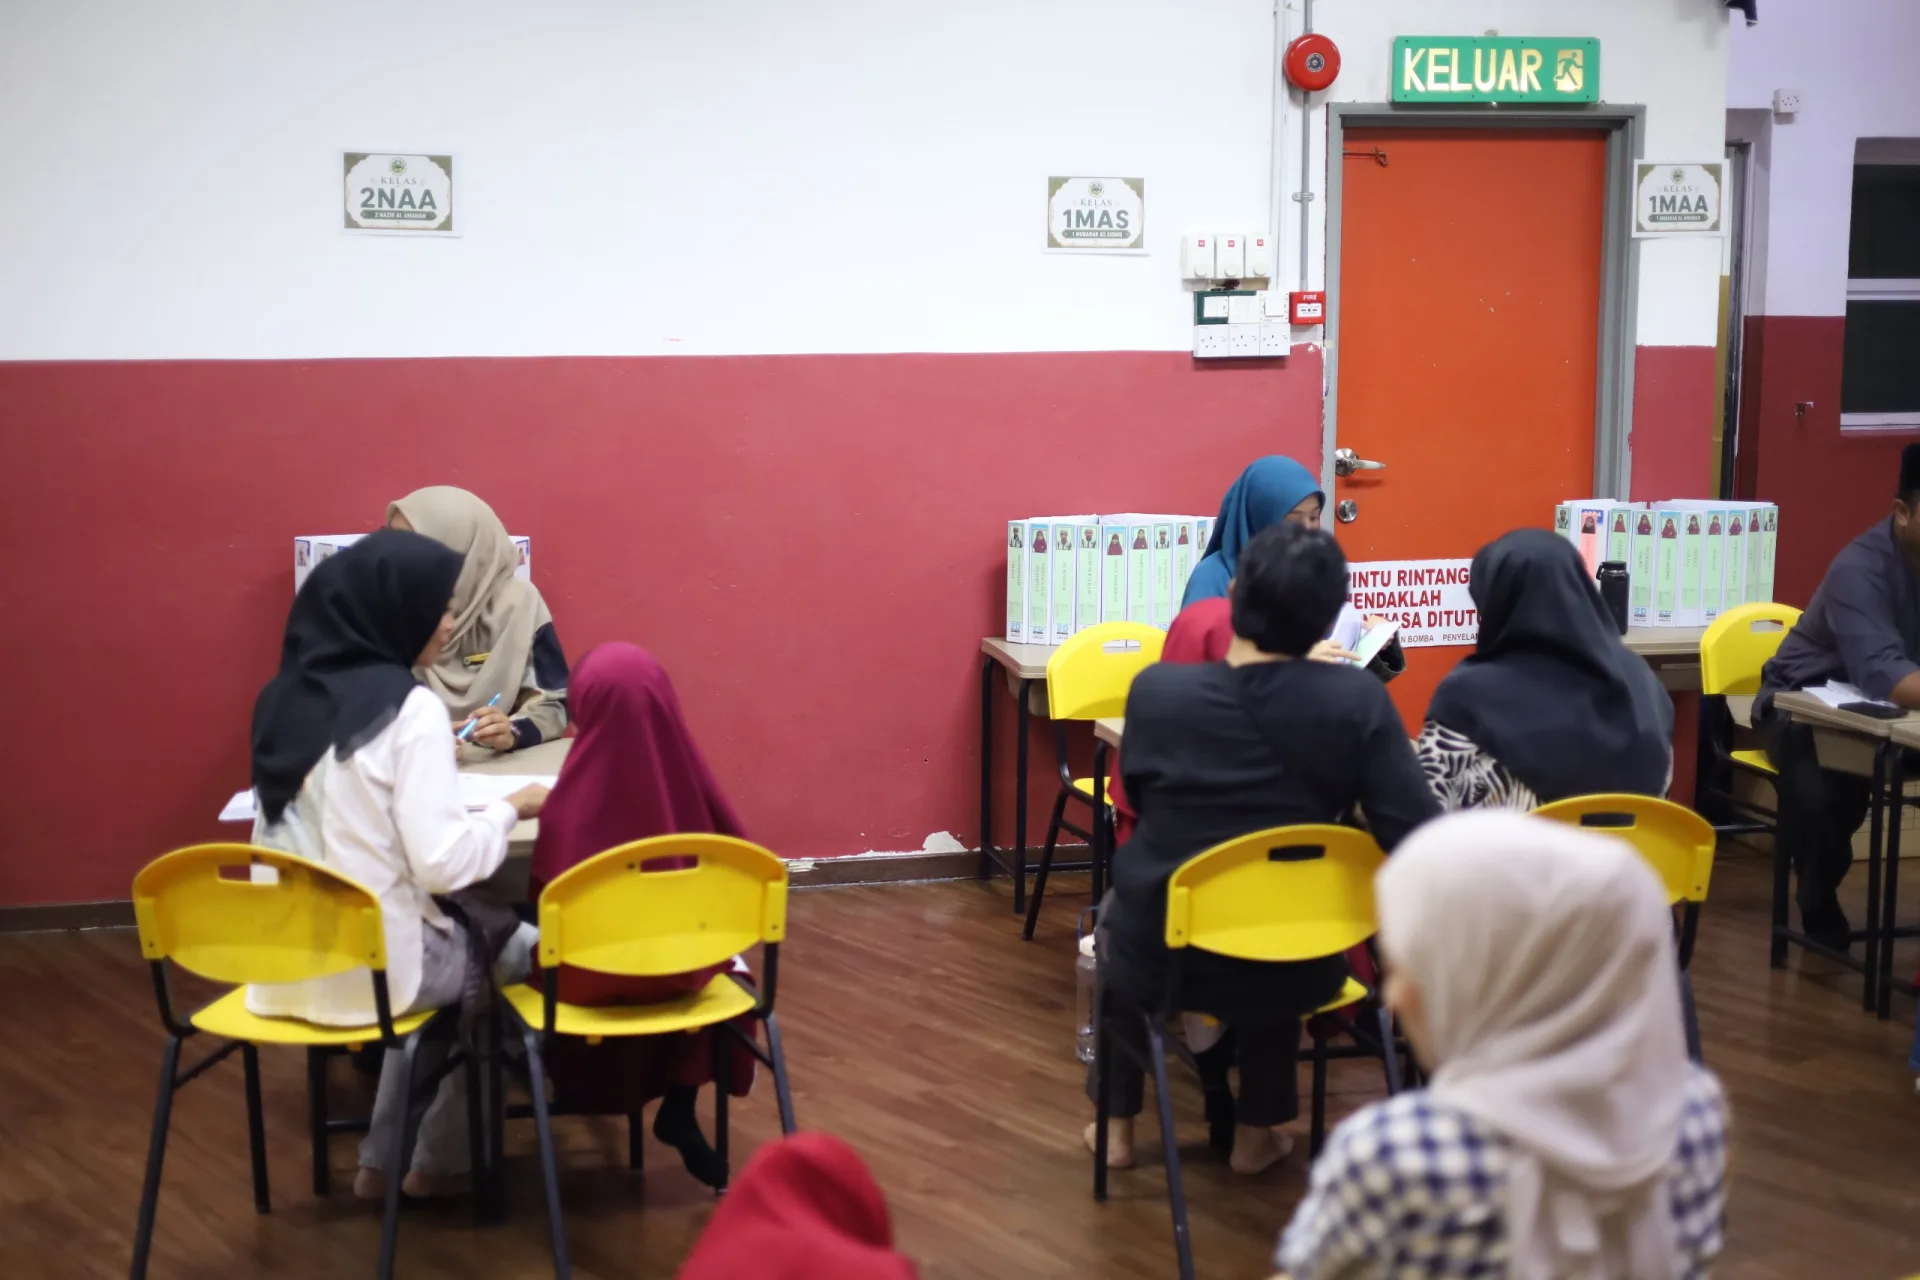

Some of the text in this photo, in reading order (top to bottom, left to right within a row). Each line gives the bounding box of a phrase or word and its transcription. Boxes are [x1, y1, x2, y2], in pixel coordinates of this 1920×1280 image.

[1403, 47, 1542, 92] KELUAR
[380, 176, 418, 185] KELAS
[1663, 185, 1692, 193] KELAS
[360, 187, 437, 210] 2NAA
[1080, 198, 1113, 207] KELAS
[1649, 195, 1709, 213] 1MAA
[1063, 209, 1129, 229] 1MAS
[1408, 634, 1434, 643] BOMBA
